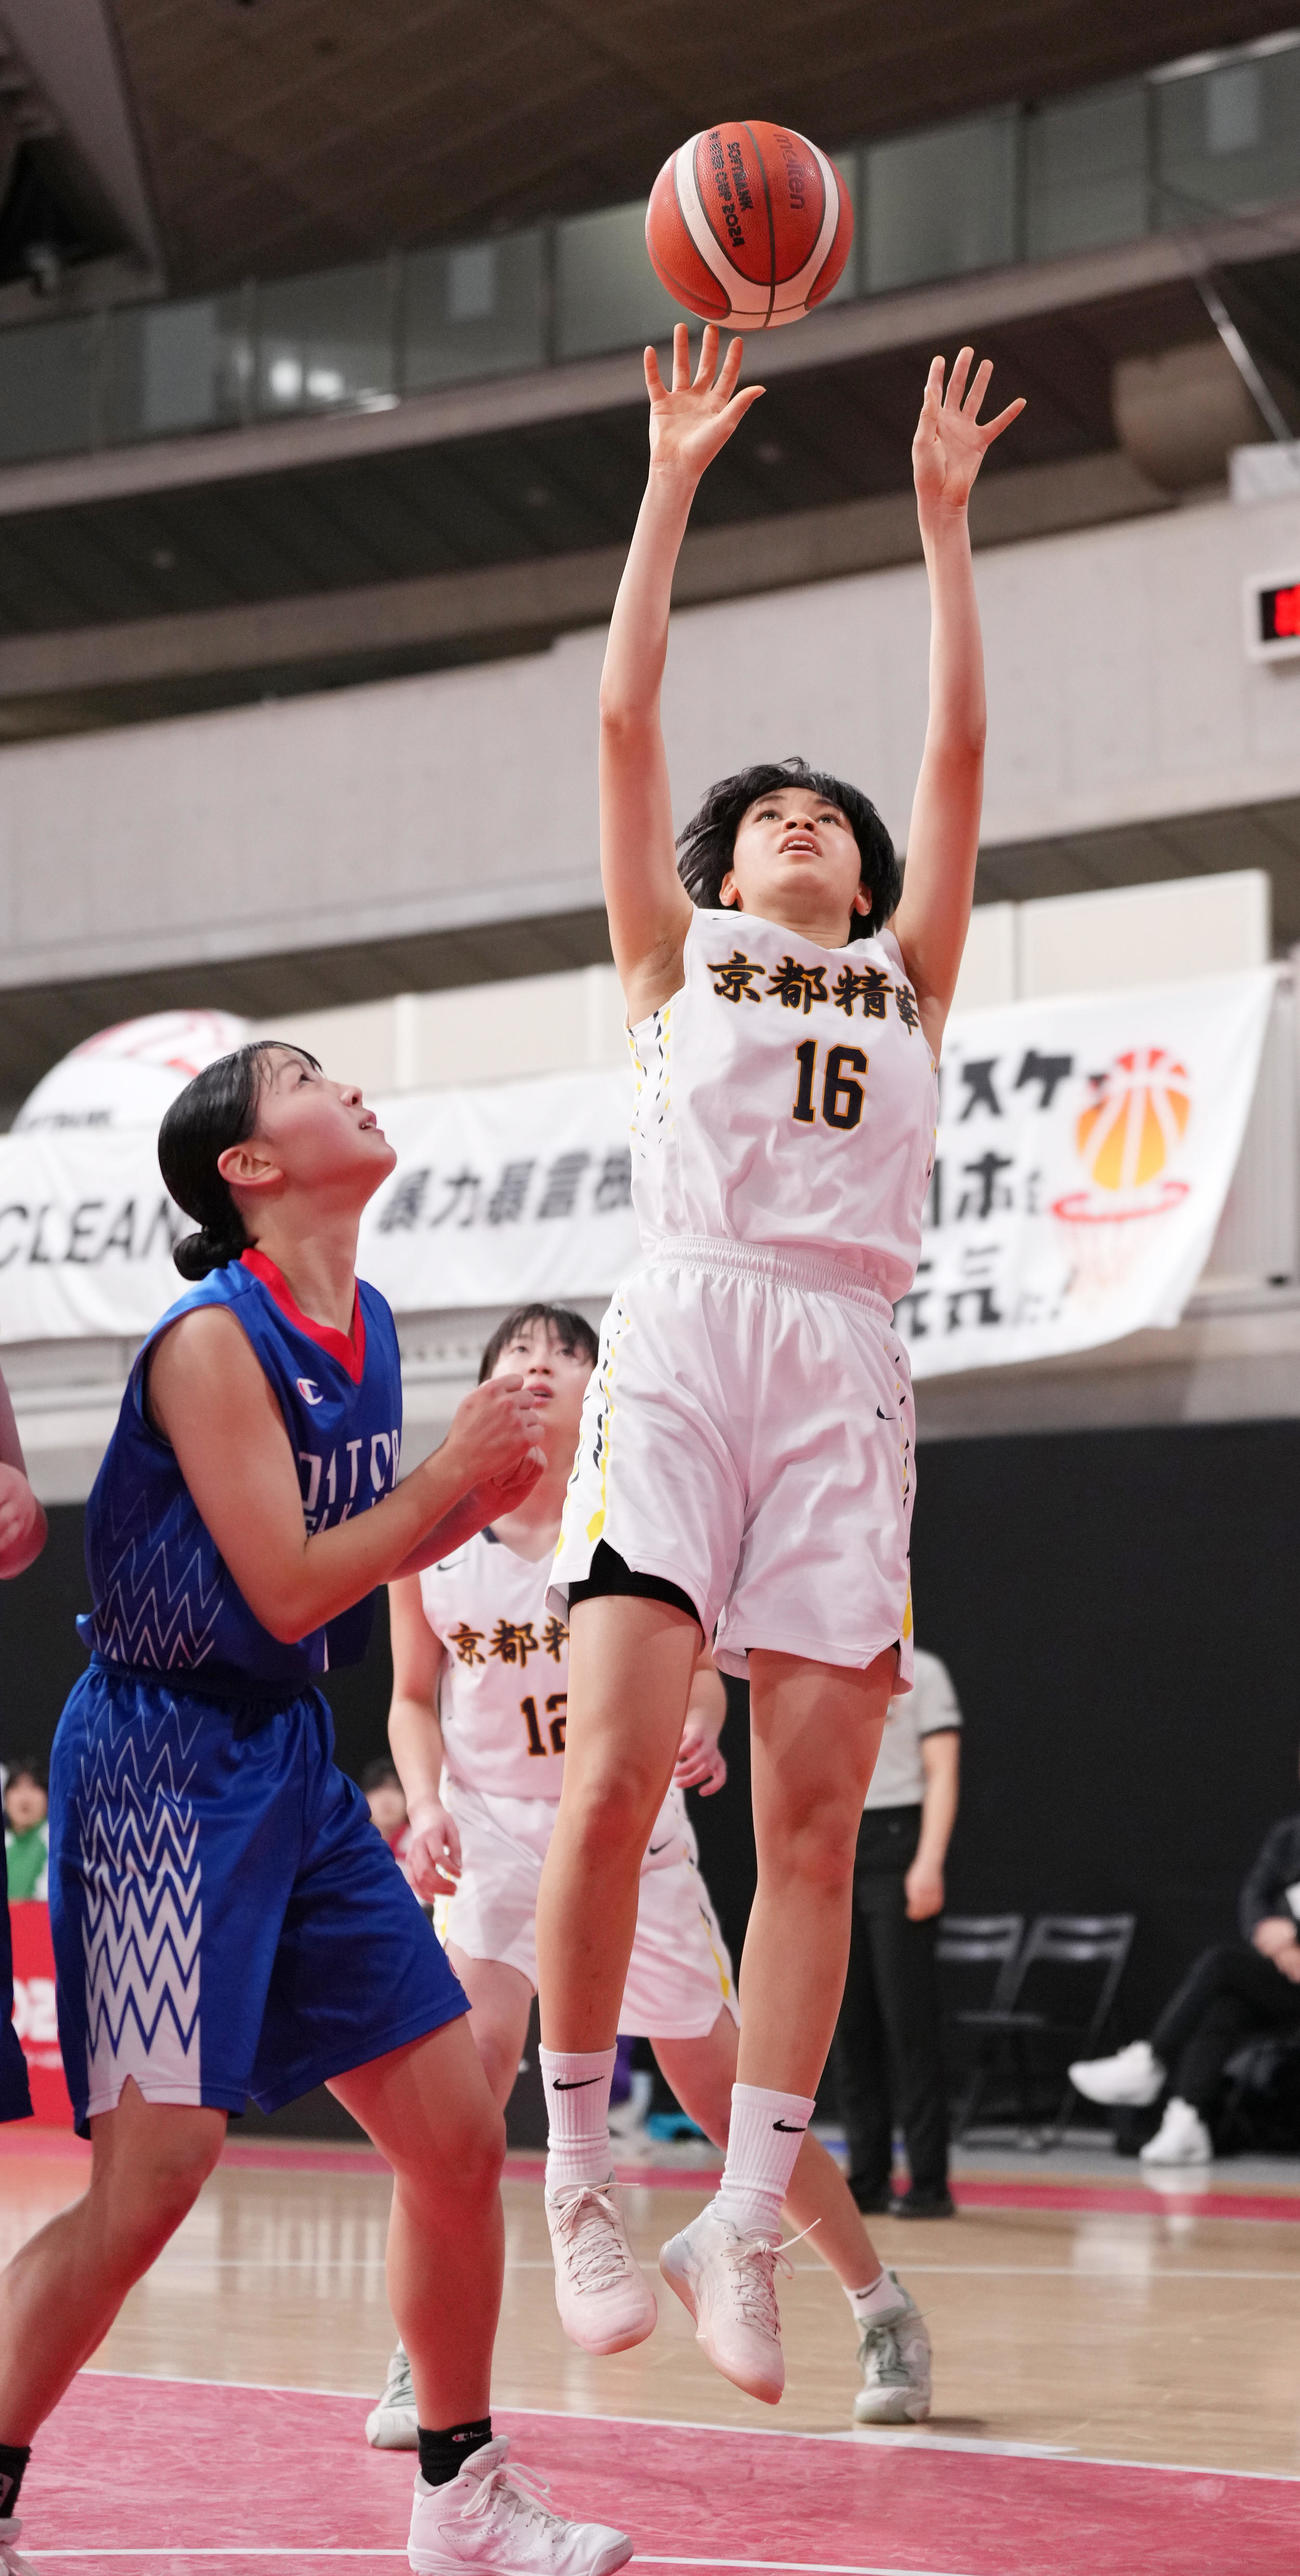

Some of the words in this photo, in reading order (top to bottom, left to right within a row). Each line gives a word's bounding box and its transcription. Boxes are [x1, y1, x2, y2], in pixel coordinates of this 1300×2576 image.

[726, 141, 754, 212] SOFTBANK
[773, 133, 806, 210] molten
[721, 203, 745, 247] 2024
[707, 951, 919, 1035] 京都精華
[792, 1039, 869, 1130] 16
